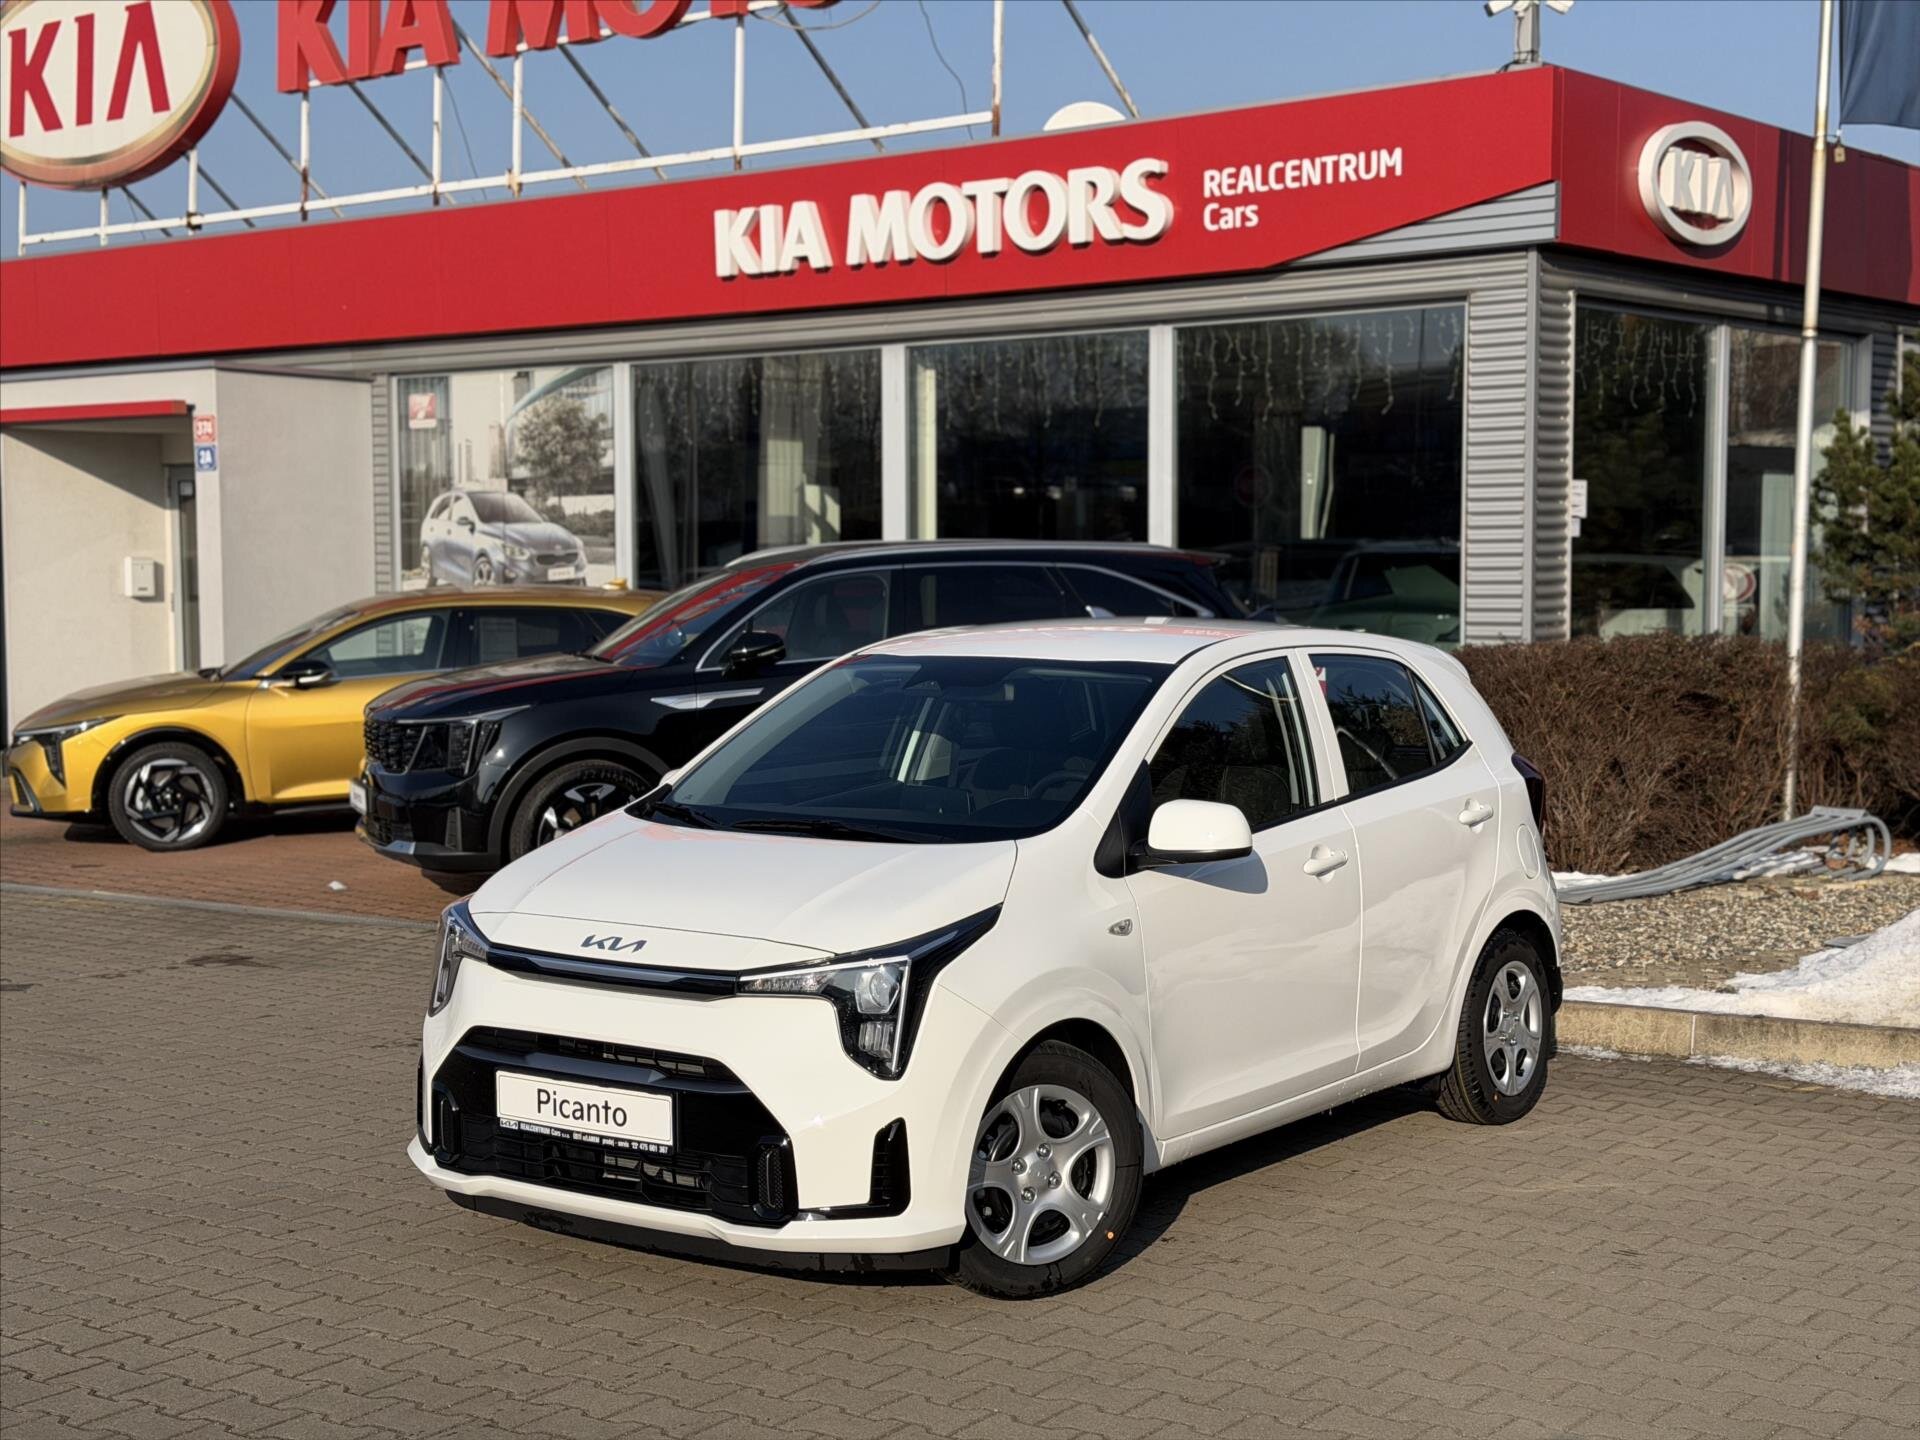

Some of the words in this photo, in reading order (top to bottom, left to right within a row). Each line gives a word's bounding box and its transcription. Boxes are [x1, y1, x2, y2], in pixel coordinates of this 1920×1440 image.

[8, 1, 171, 138] KIA
[278, 0, 459, 93] KIA
[1203, 147, 1403, 199] REALCENTRUM
[1662, 146, 1735, 220] KIA
[714, 203, 834, 278] KIA
[846, 158, 1174, 266] MOTORS
[1203, 202, 1260, 232] Cars
[581, 934, 647, 953] KIA
[536, 1088, 627, 1127] Picanto
